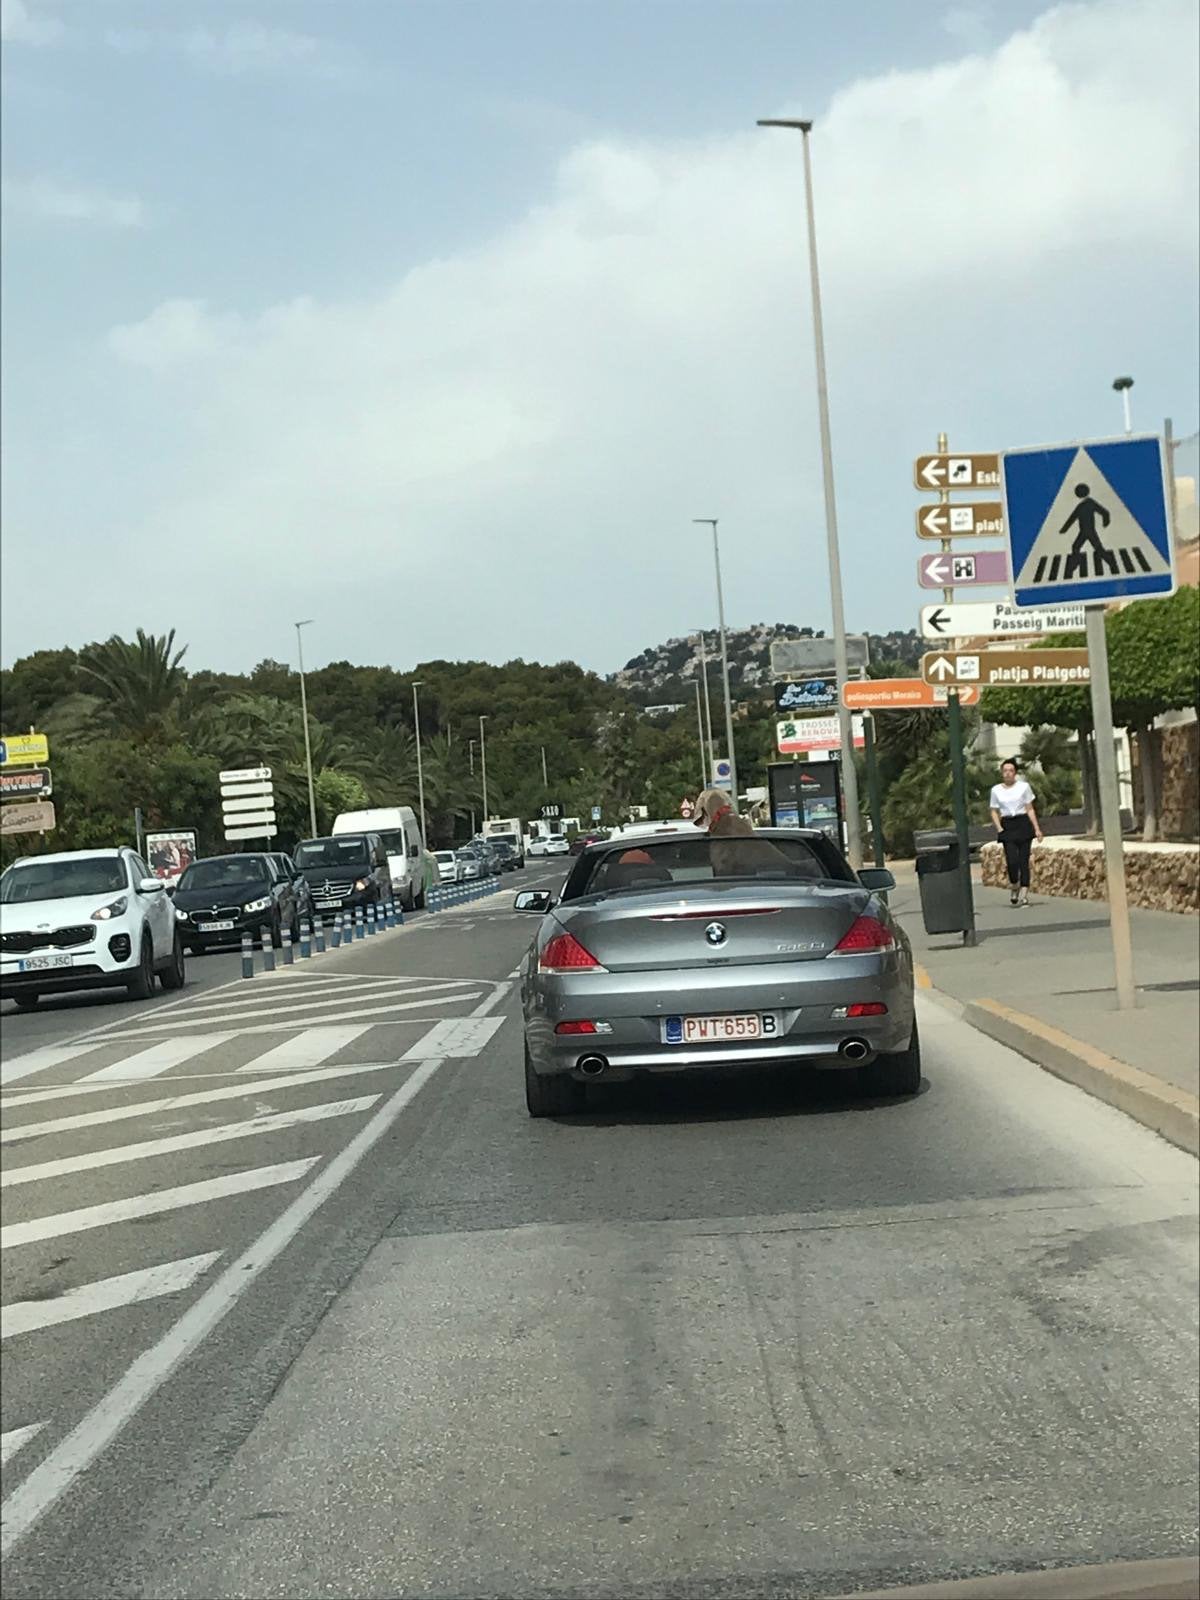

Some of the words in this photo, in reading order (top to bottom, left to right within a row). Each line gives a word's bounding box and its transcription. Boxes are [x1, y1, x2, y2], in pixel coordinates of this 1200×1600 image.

[976, 518, 1003, 534] platj
[993, 617, 1042, 631] Passeig
[989, 665, 1029, 683] platja
[1033, 664, 1090, 683] Platgete
[541, 805, 559, 817] SAXO
[25, 958, 49, 969] 9525
[52, 955, 70, 966] JSC
[762, 1015, 776, 1033] B
